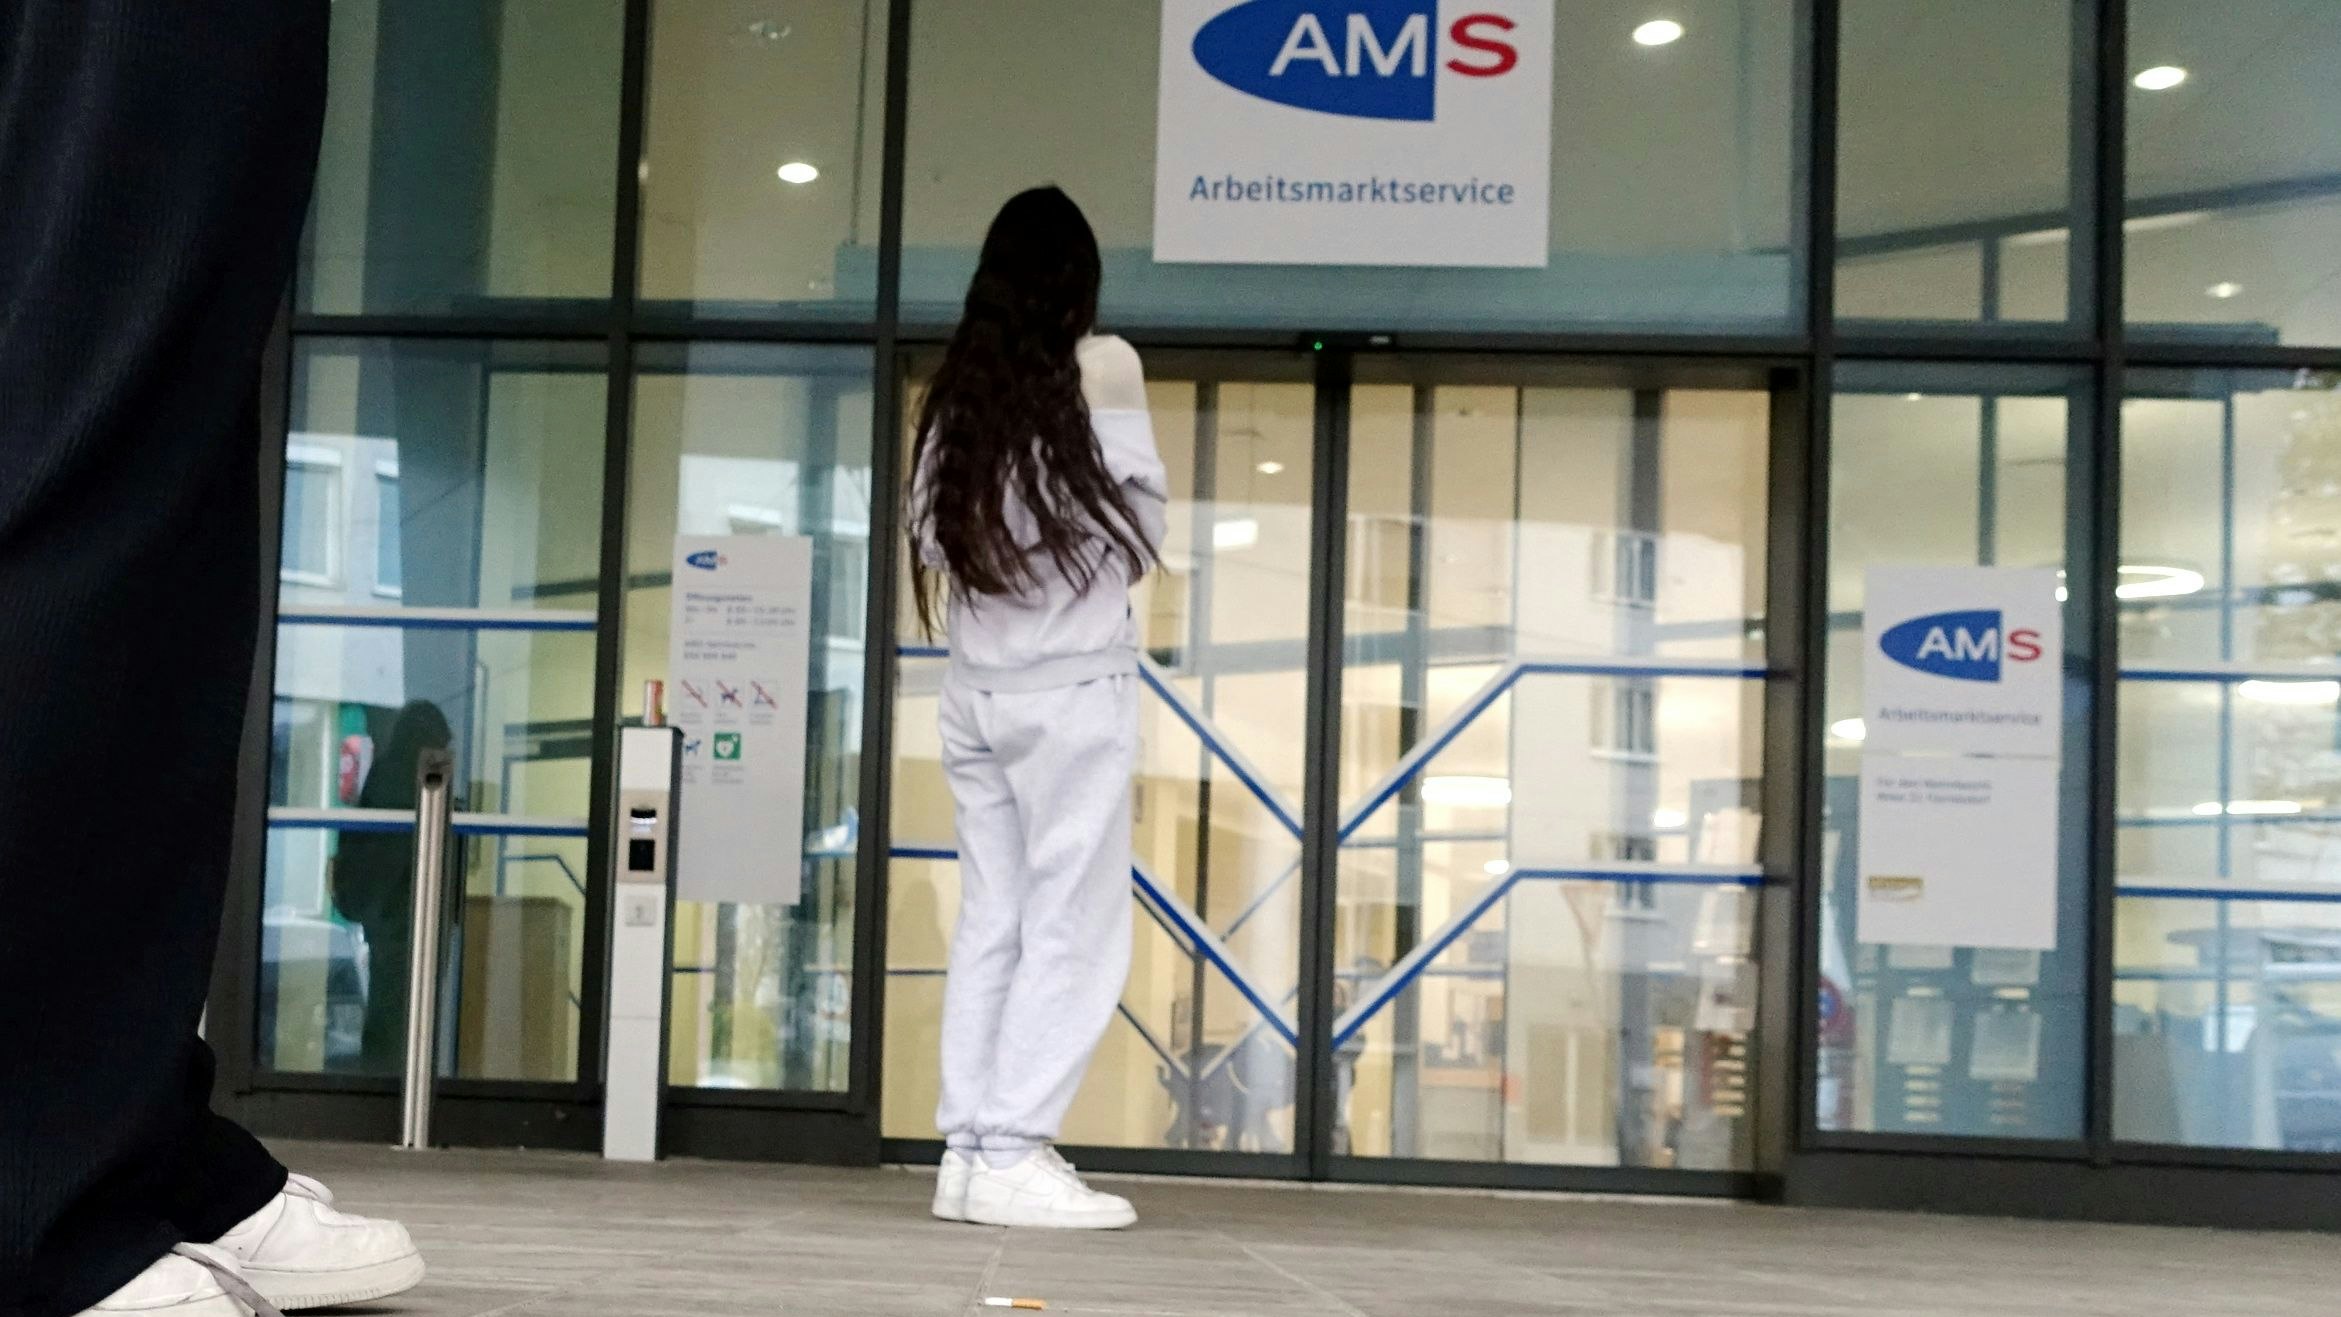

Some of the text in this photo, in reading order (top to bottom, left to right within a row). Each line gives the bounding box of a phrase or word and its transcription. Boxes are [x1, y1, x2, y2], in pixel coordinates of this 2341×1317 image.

[1268, 12, 1518, 79] AMS
[1189, 175, 1515, 205] Arbeitsmarktservice
[1915, 626, 2042, 663] AMS
